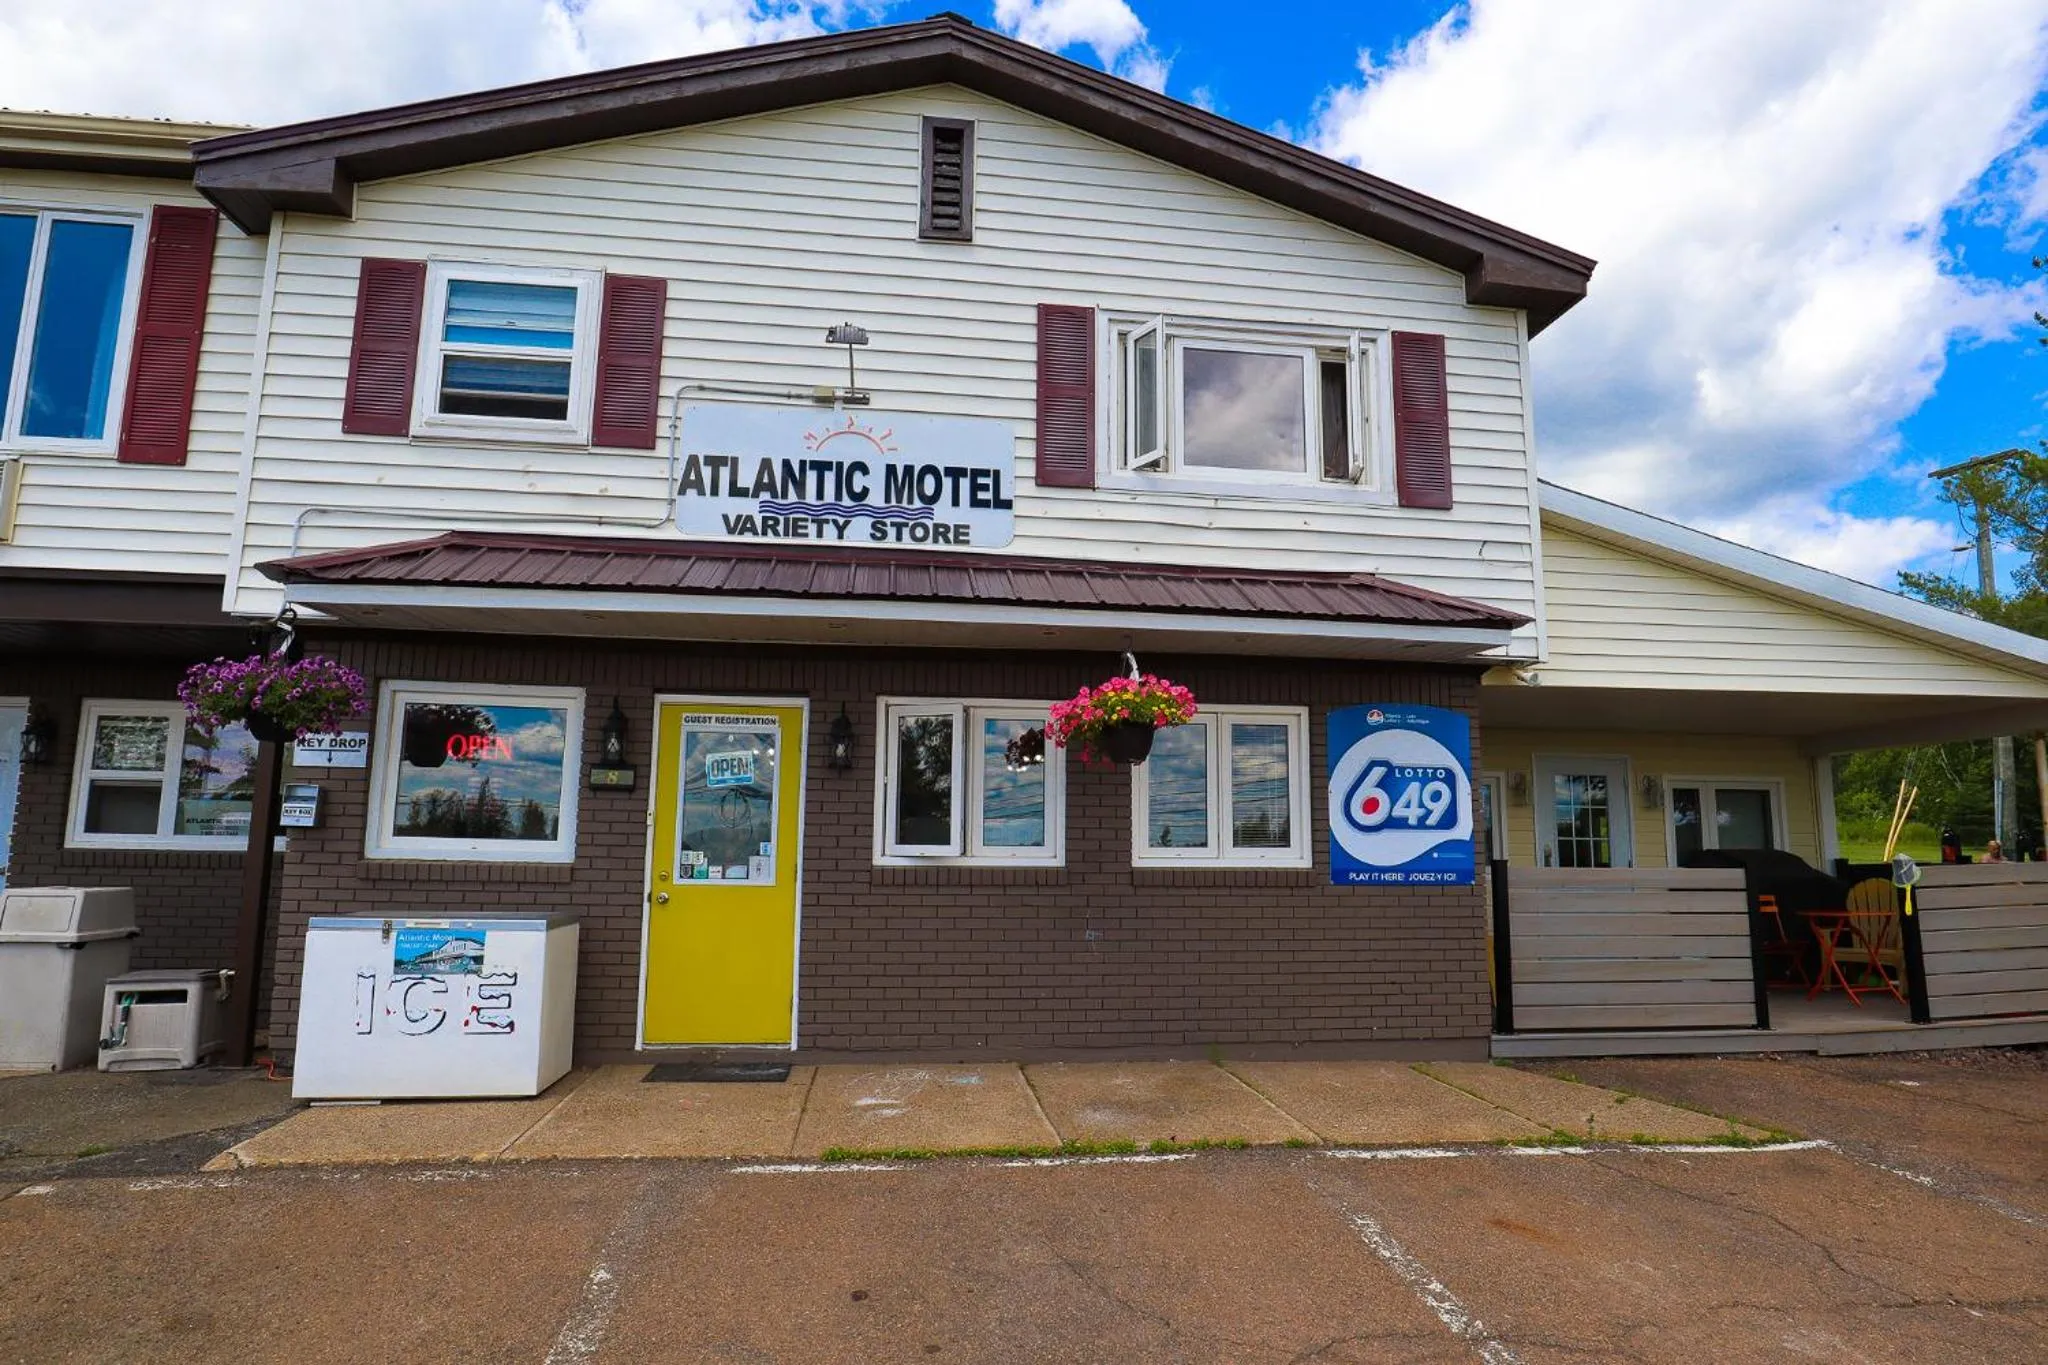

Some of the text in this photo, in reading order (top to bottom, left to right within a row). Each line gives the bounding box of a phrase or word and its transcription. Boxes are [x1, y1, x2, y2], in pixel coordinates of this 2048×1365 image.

[678, 454, 1013, 510] ATLANTIC MOTEL
[722, 513, 971, 545] VARIETY STORE
[684, 715, 776, 726] GUEST REGISTRATION
[297, 737, 366, 748] KEY DROP
[447, 733, 513, 761] OPEN
[711, 757, 750, 778] OPEN
[1394, 768, 1446, 779] LOTTO
[1349, 872, 1370, 881] PLAY
[1371, 872, 1379, 881] IT
[356, 970, 518, 1036] ICE
